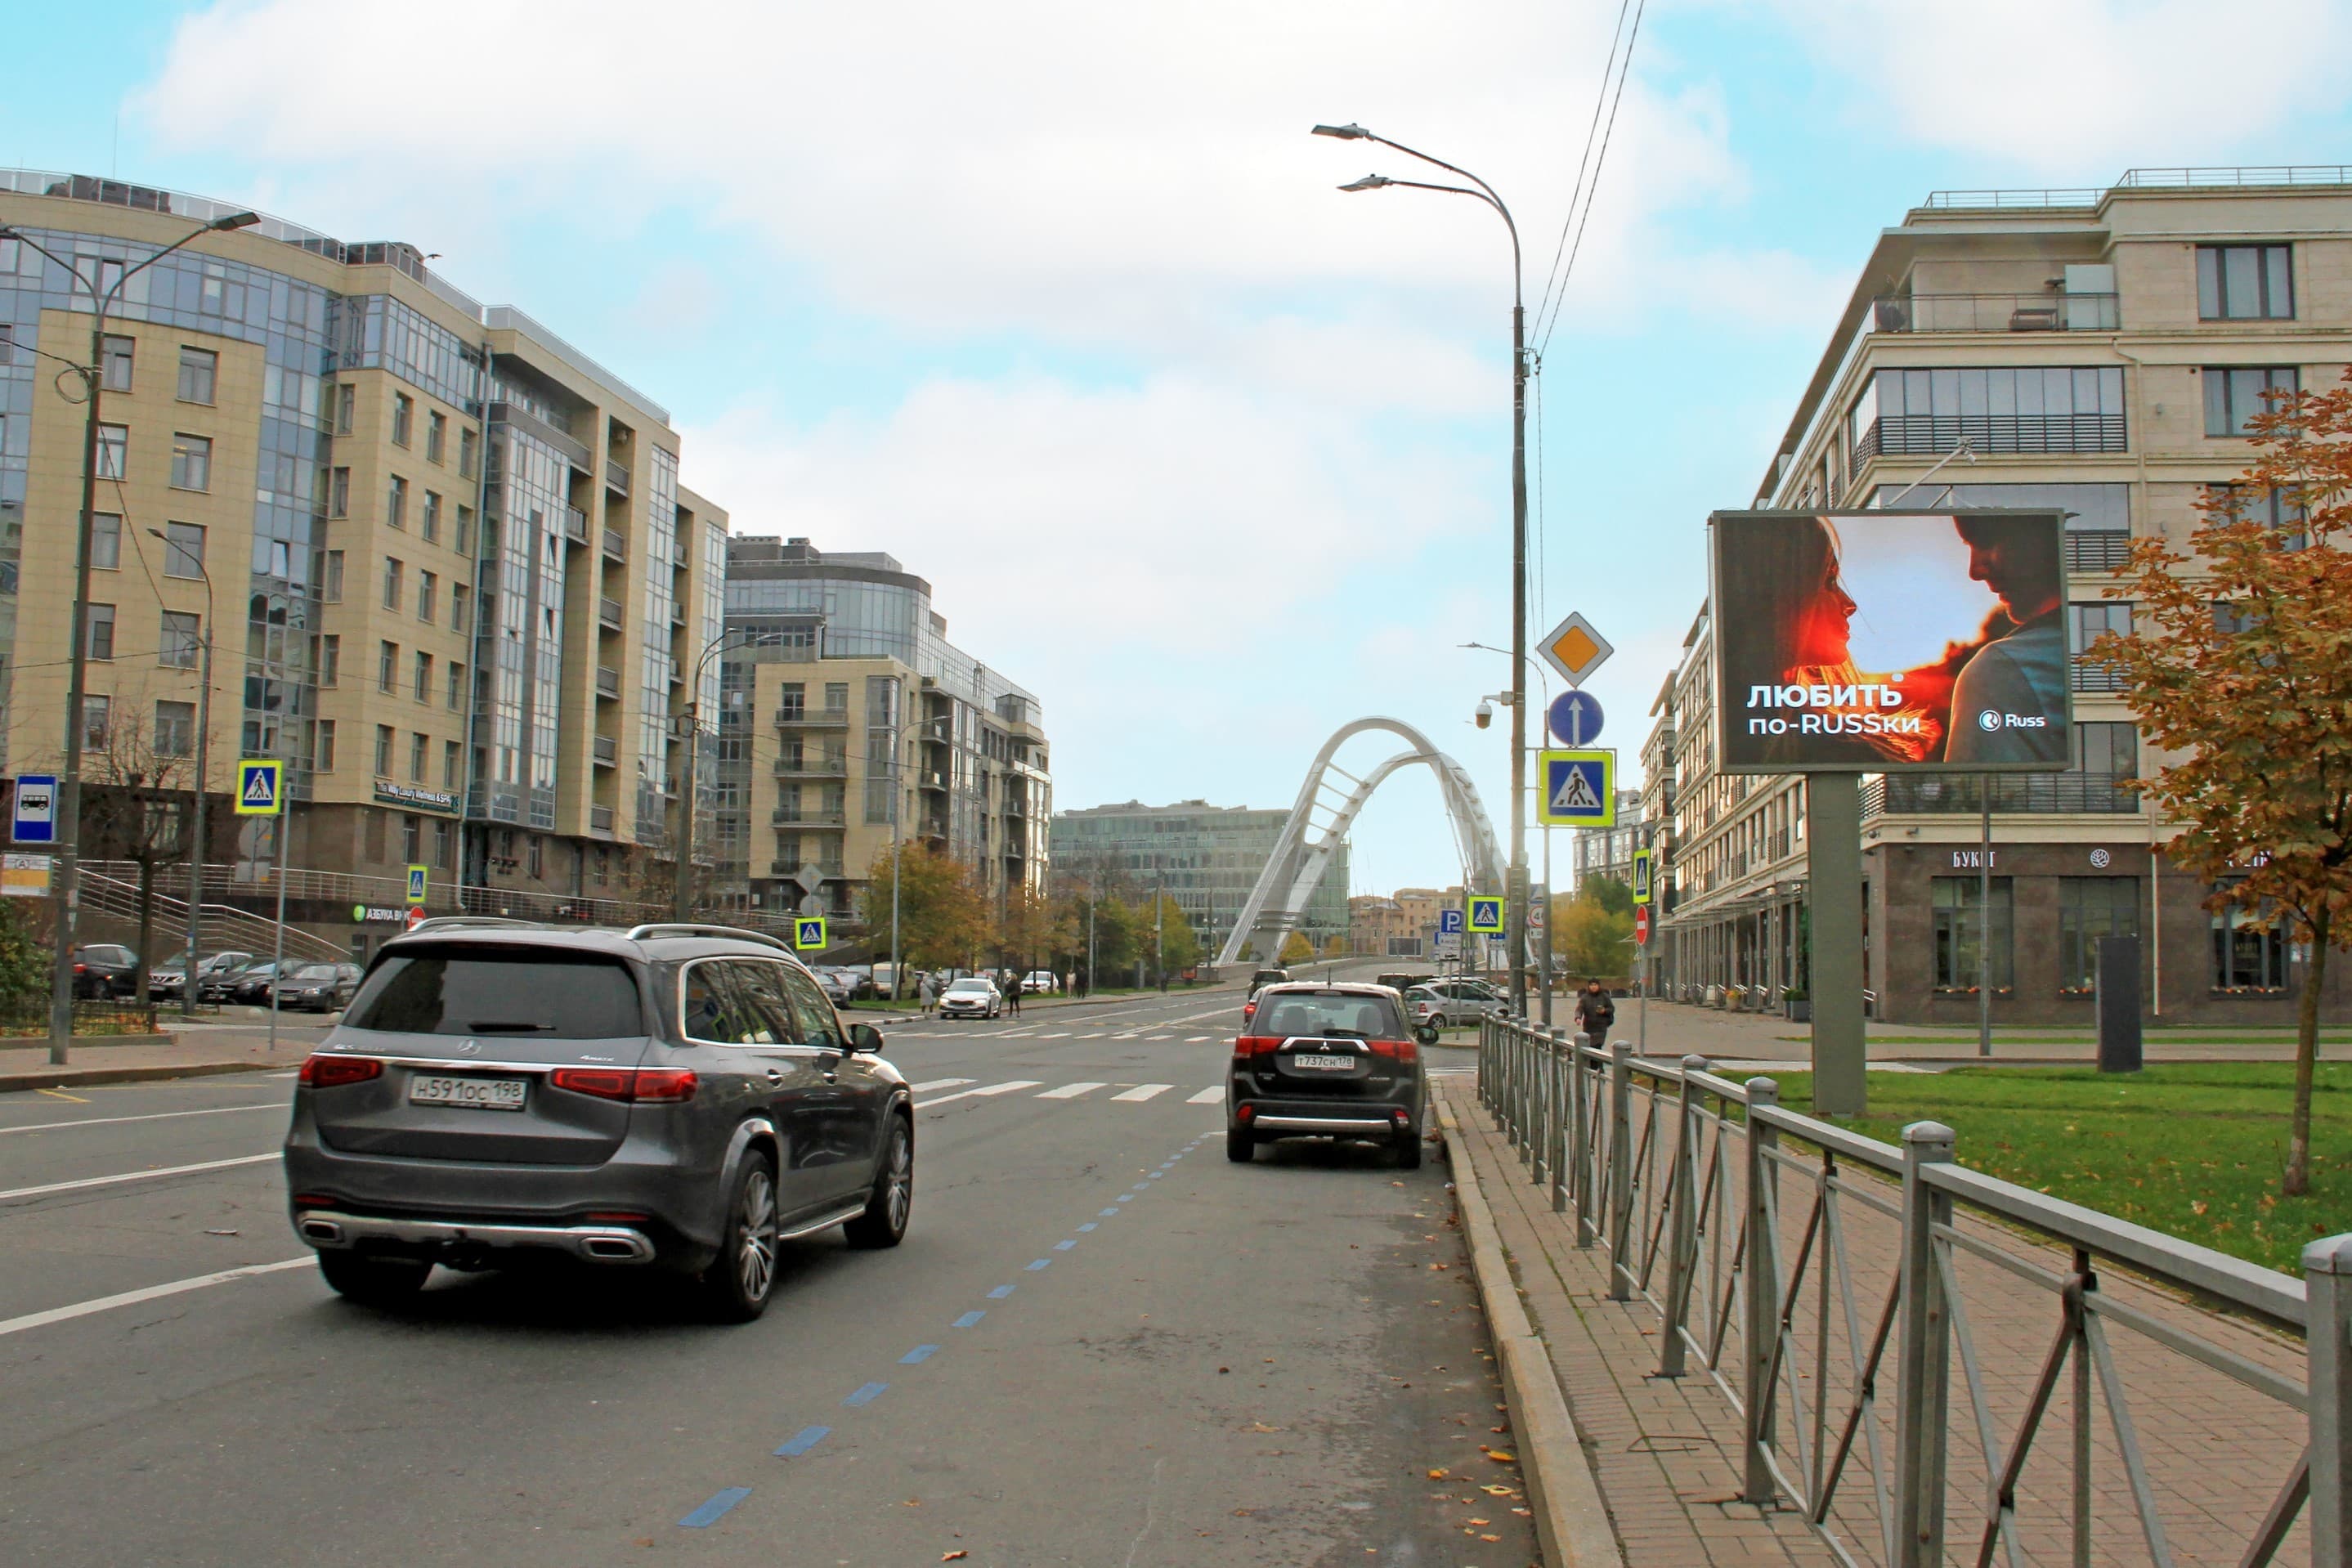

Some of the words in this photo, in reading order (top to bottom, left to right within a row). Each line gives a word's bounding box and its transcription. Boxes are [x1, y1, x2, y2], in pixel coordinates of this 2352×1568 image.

[1746, 684, 1903, 709] ЛЮБИТЬ
[1749, 713, 1920, 735] по-RUSSки
[2005, 713, 2045, 728] Russ
[366, 908, 393, 921] АЗБУКА
[493, 1082, 523, 1098] 198
